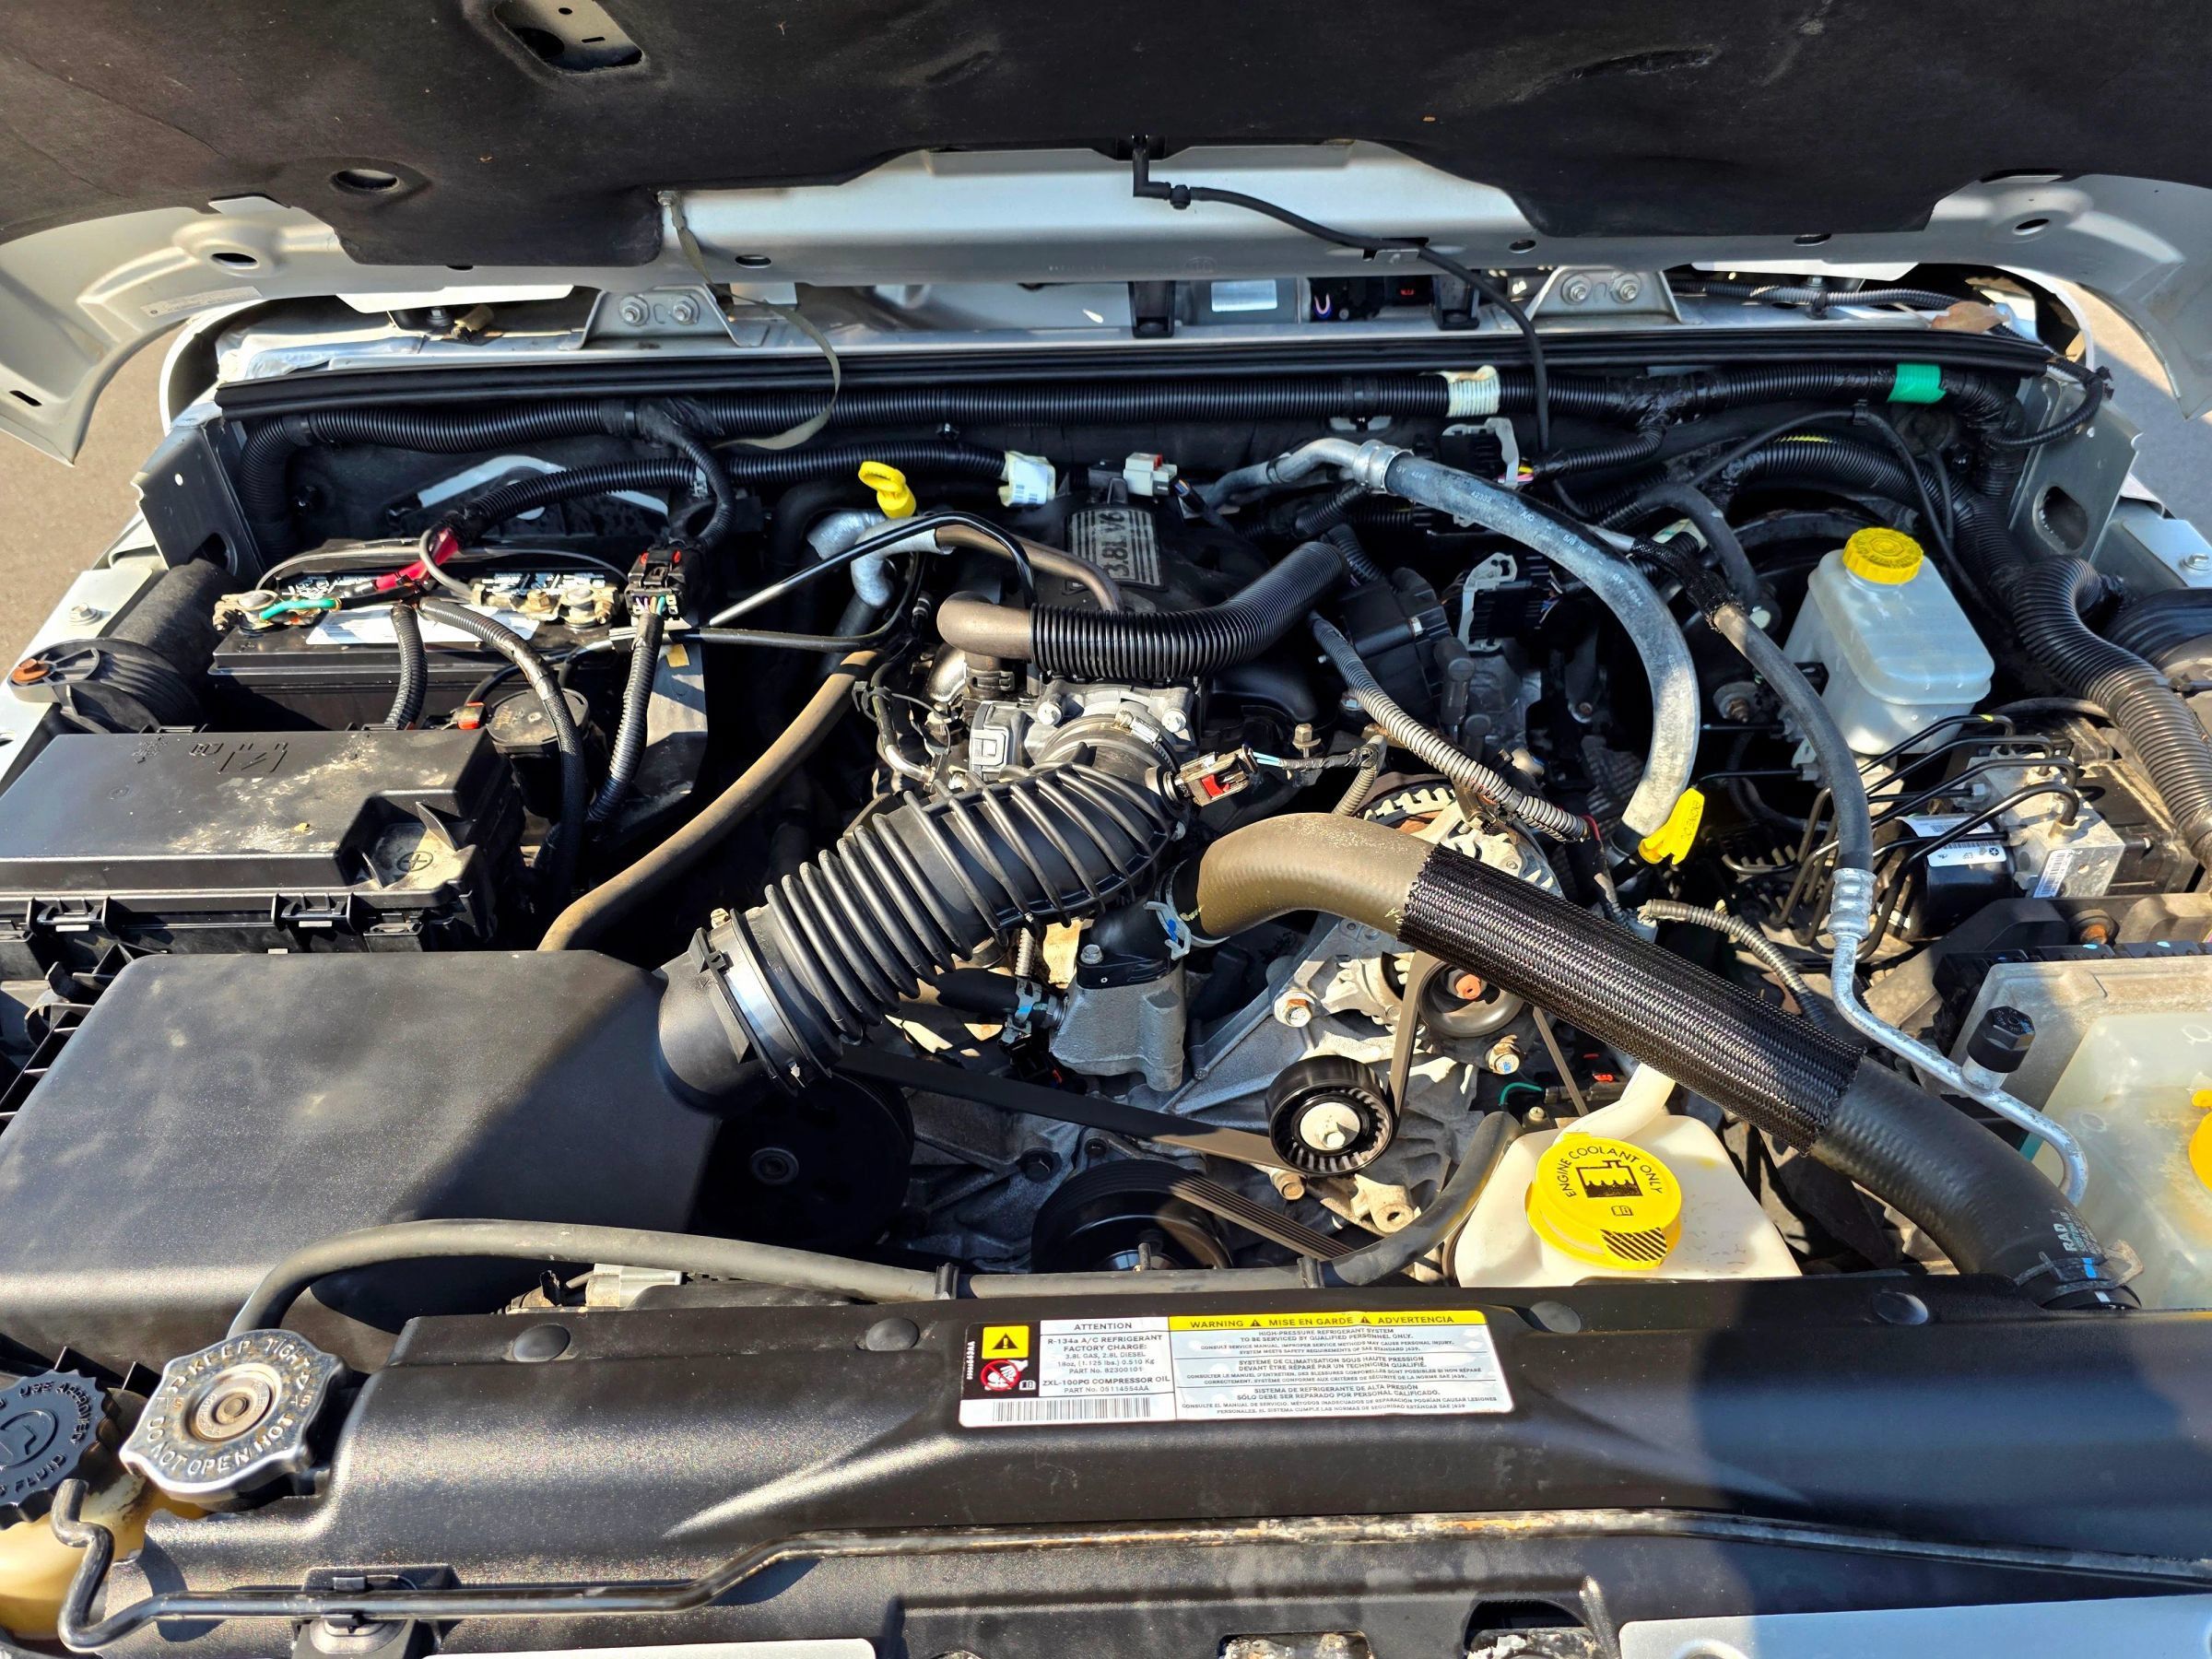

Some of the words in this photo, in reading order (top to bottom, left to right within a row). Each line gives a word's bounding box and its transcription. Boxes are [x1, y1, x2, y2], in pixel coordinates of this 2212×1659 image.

[1099, 511, 1125, 533] V6
[1578, 542, 1587, 553] IN
[1557, 1158, 1577, 1197] ENGINE
[1569, 1146, 1641, 1163] COOLANT
[1641, 1165, 1663, 1194] ONLY
[2053, 1224, 2077, 1252] RAD
[1074, 1323, 1132, 1331] ATTENTION
[1191, 1320, 1243, 1328] WARNING
[1316, 1316, 1353, 1325] GARDE
[1378, 1316, 1454, 1324] ADVERTENCIA
[1100, 1335, 1162, 1343] REFRIGERANT
[188, 1339, 252, 1375] KEEP
[265, 1337, 311, 1371] TIGHT
[20, 1382, 54, 1397] USE
[147, 1416, 166, 1442] DO
[254, 1413, 295, 1453] HOT
[151, 1442, 188, 1471] NOT
[187, 1448, 252, 1476] OPEN
[15, 1454, 67, 1492] FLUID
